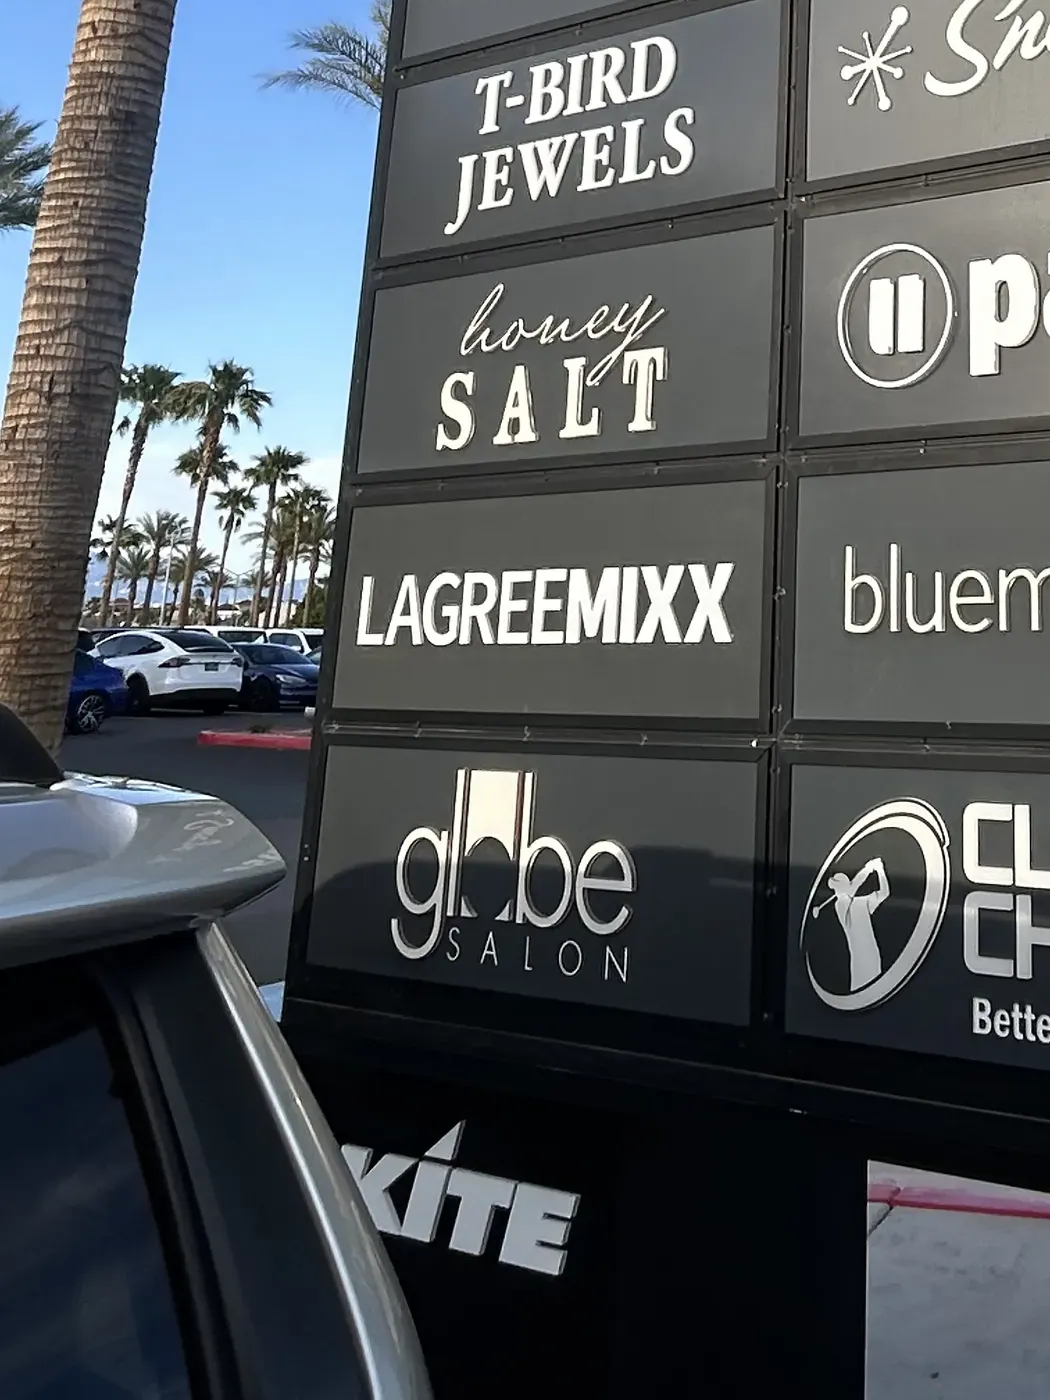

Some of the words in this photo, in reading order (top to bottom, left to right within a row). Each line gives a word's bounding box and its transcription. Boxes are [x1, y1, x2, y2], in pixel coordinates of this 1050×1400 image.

[475, 35, 678, 135] T-BIRD
[443, 106, 696, 236] JEWELS
[459, 283, 667, 387] honey
[435, 346, 669, 451] SALT
[356, 562, 735, 646] LAGREEMIXX
[446, 926, 630, 983] SALON
